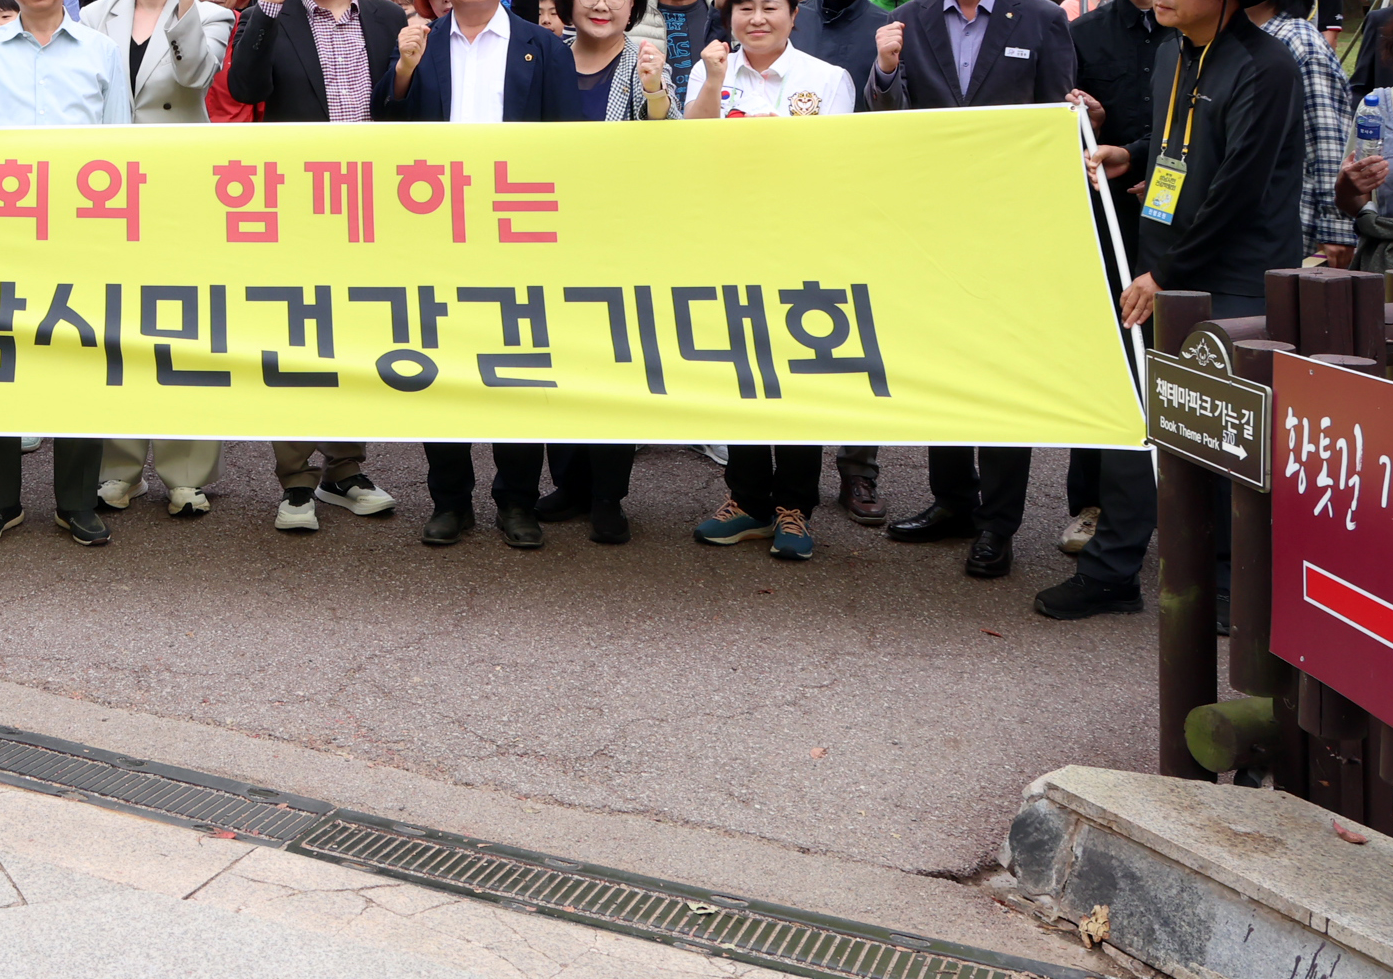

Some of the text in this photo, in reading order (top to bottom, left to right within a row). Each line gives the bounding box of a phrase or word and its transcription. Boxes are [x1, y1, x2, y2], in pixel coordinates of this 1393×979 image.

[212, 159, 559, 243] 함께하는
[1156, 377, 1254, 441] 책테마파크 가는 길
[1159, 415, 1220, 451] Book Theme Park
[1222, 430, 1236, 445] 570
[1285, 406, 1364, 531] 황톳길
